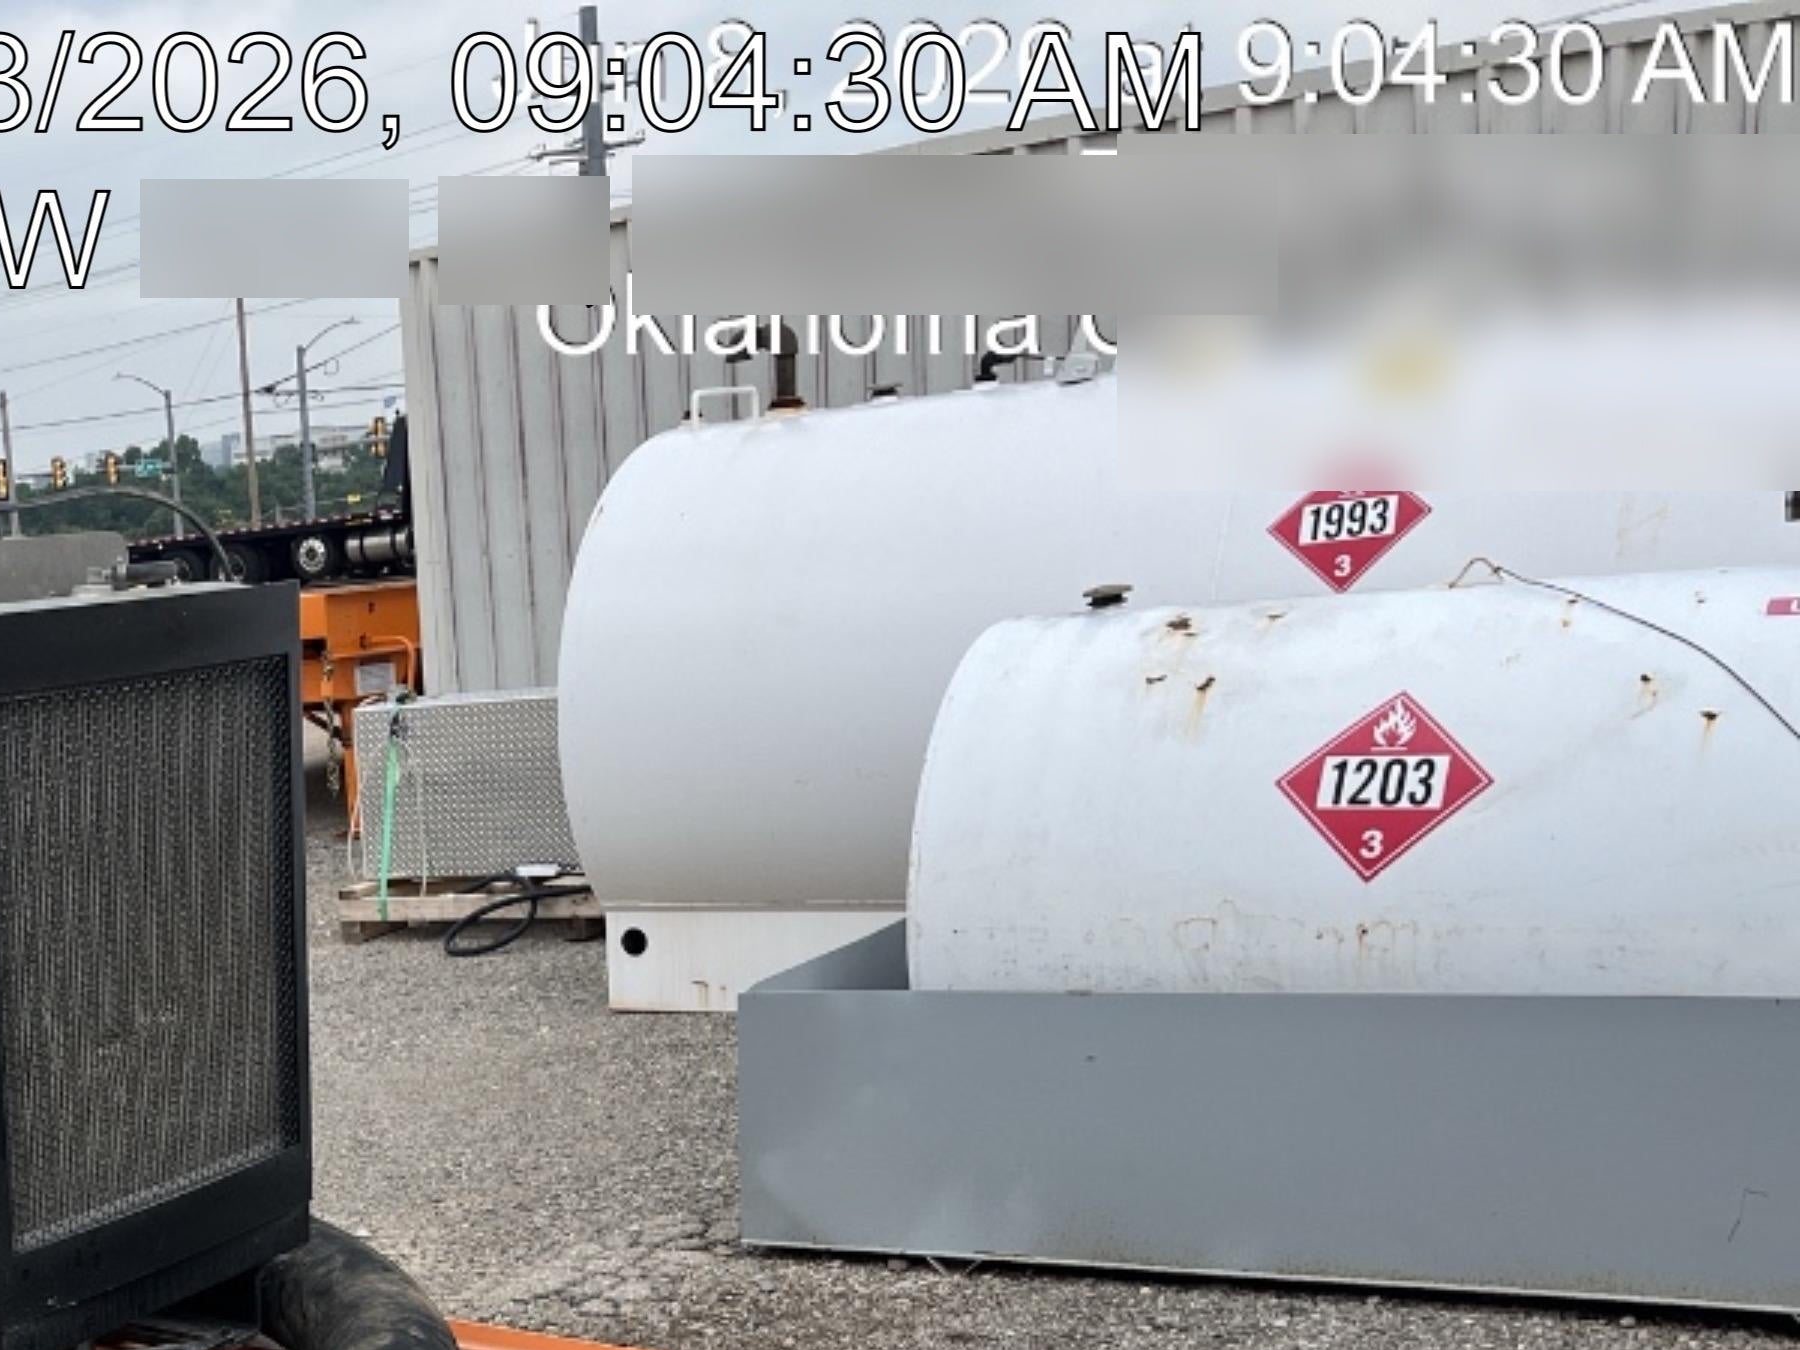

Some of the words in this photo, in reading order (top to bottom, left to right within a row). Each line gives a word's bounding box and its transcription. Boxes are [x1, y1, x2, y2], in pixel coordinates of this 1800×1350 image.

[1308, 497, 1391, 542] 1993
[1333, 554, 1352, 578] 3
[1330, 757, 1437, 807] 1203
[1359, 829, 1385, 860] 3
